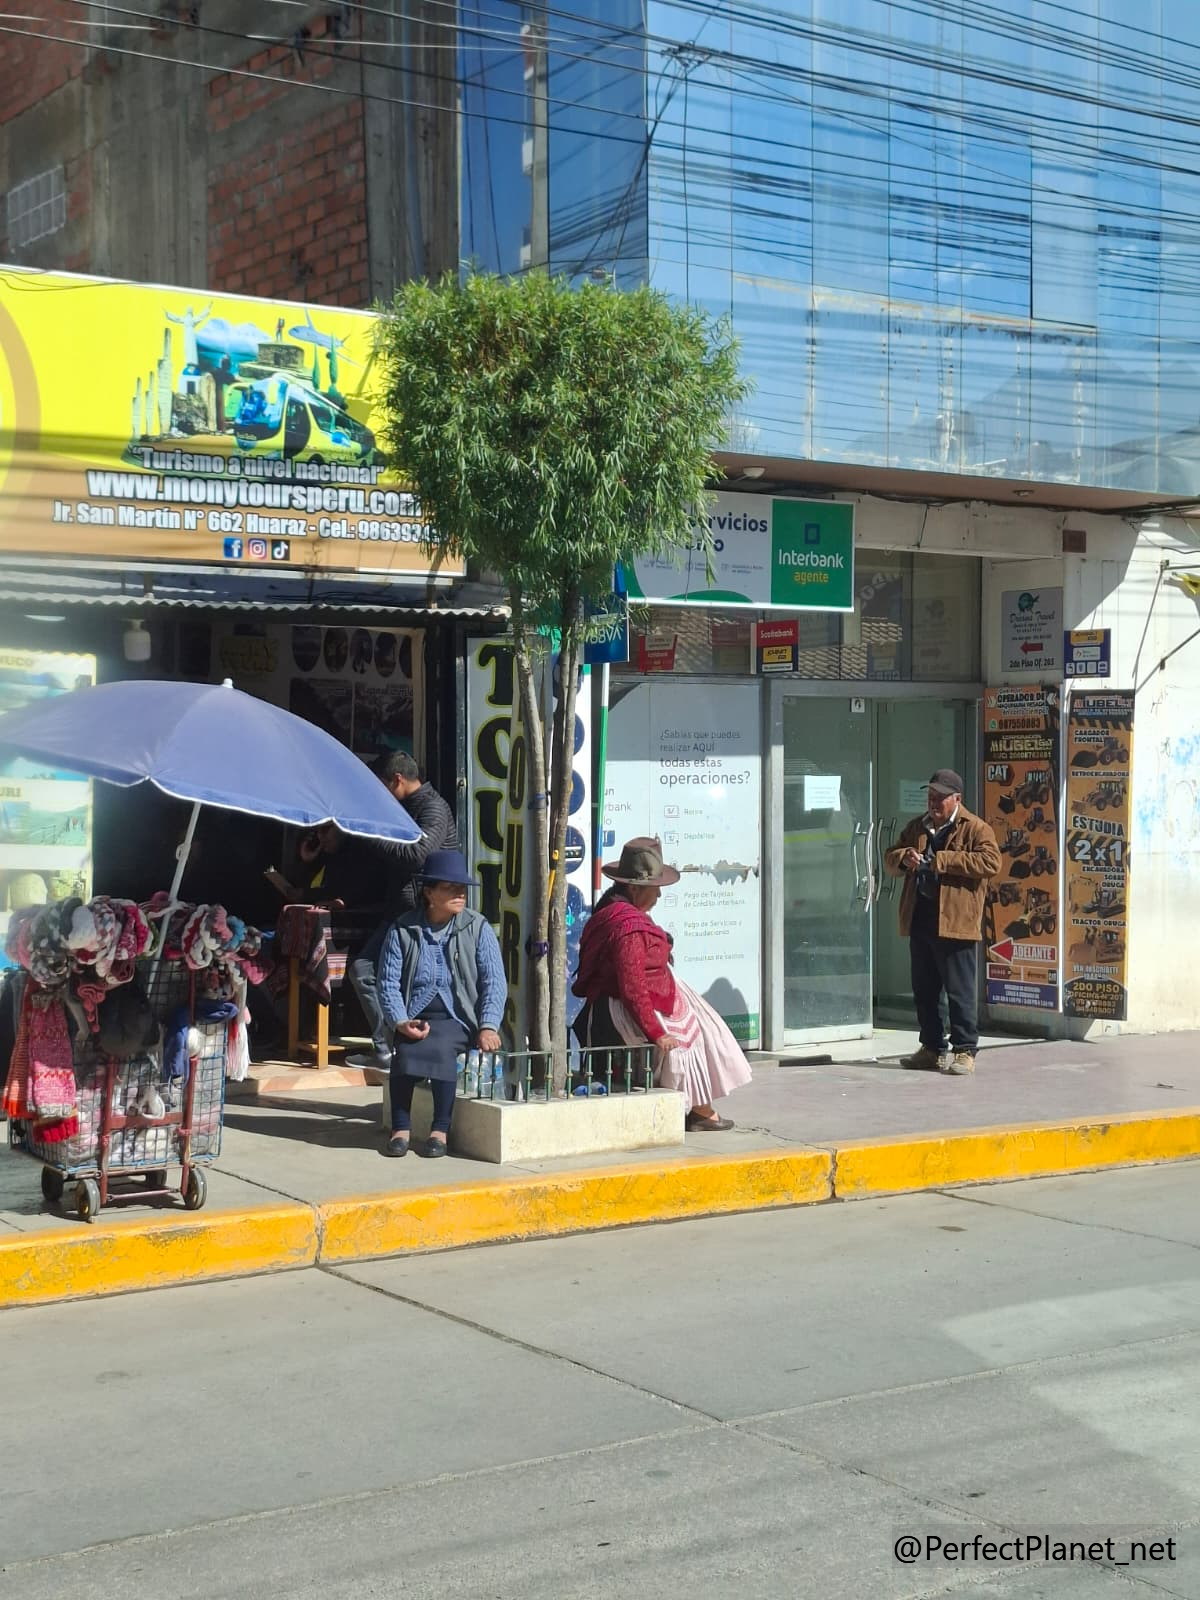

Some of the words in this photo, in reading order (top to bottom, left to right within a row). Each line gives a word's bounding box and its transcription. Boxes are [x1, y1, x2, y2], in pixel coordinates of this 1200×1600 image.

[228, 458, 241, 474] a
[244, 457, 292, 479] nivel
[87, 469, 422, 518] www.monytoursperu.com
[53, 501, 74, 523] Jr.
[77, 502, 114, 525] San
[118, 505, 180, 530] Martín
[208, 511, 243, 533] 662
[246, 514, 307, 536] Huaraz
[778, 548, 845, 570] Interbank
[793, 570, 830, 585] agente
[693, 731, 710, 741] que
[660, 743, 691, 752] realizar
[660, 757, 691, 768] todas
[693, 758, 722, 768] estas
[659, 770, 751, 789] operaciones?
[988, 765, 1009, 781] CAT
[1072, 815, 1125, 836] ESTUDIA
[1012, 945, 1053, 960] ADELANTE
[1073, 982, 1093, 992] 2DO
[1096, 984, 1120, 994] PISO
